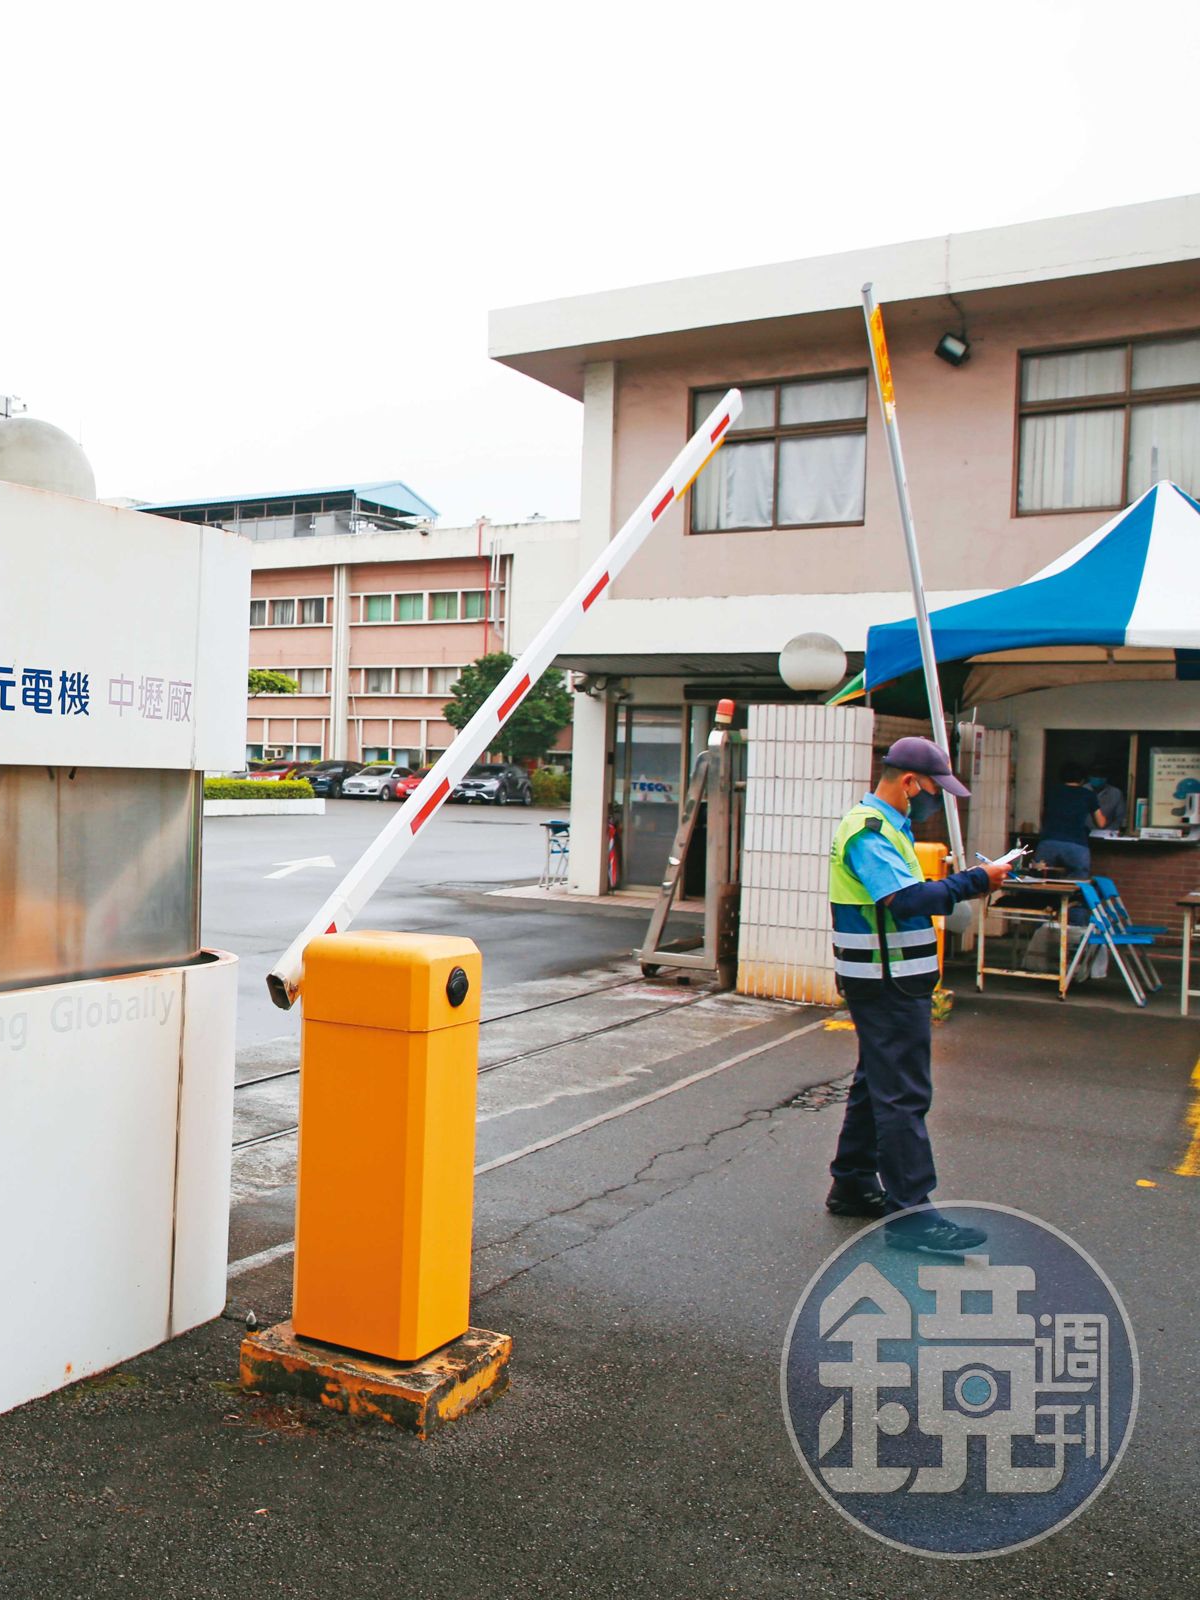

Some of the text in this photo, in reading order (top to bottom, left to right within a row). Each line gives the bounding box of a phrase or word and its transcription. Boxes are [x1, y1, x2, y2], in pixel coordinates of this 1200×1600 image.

[108, 673, 193, 723] 中壢廠
[50, 985, 175, 1033] Globally
